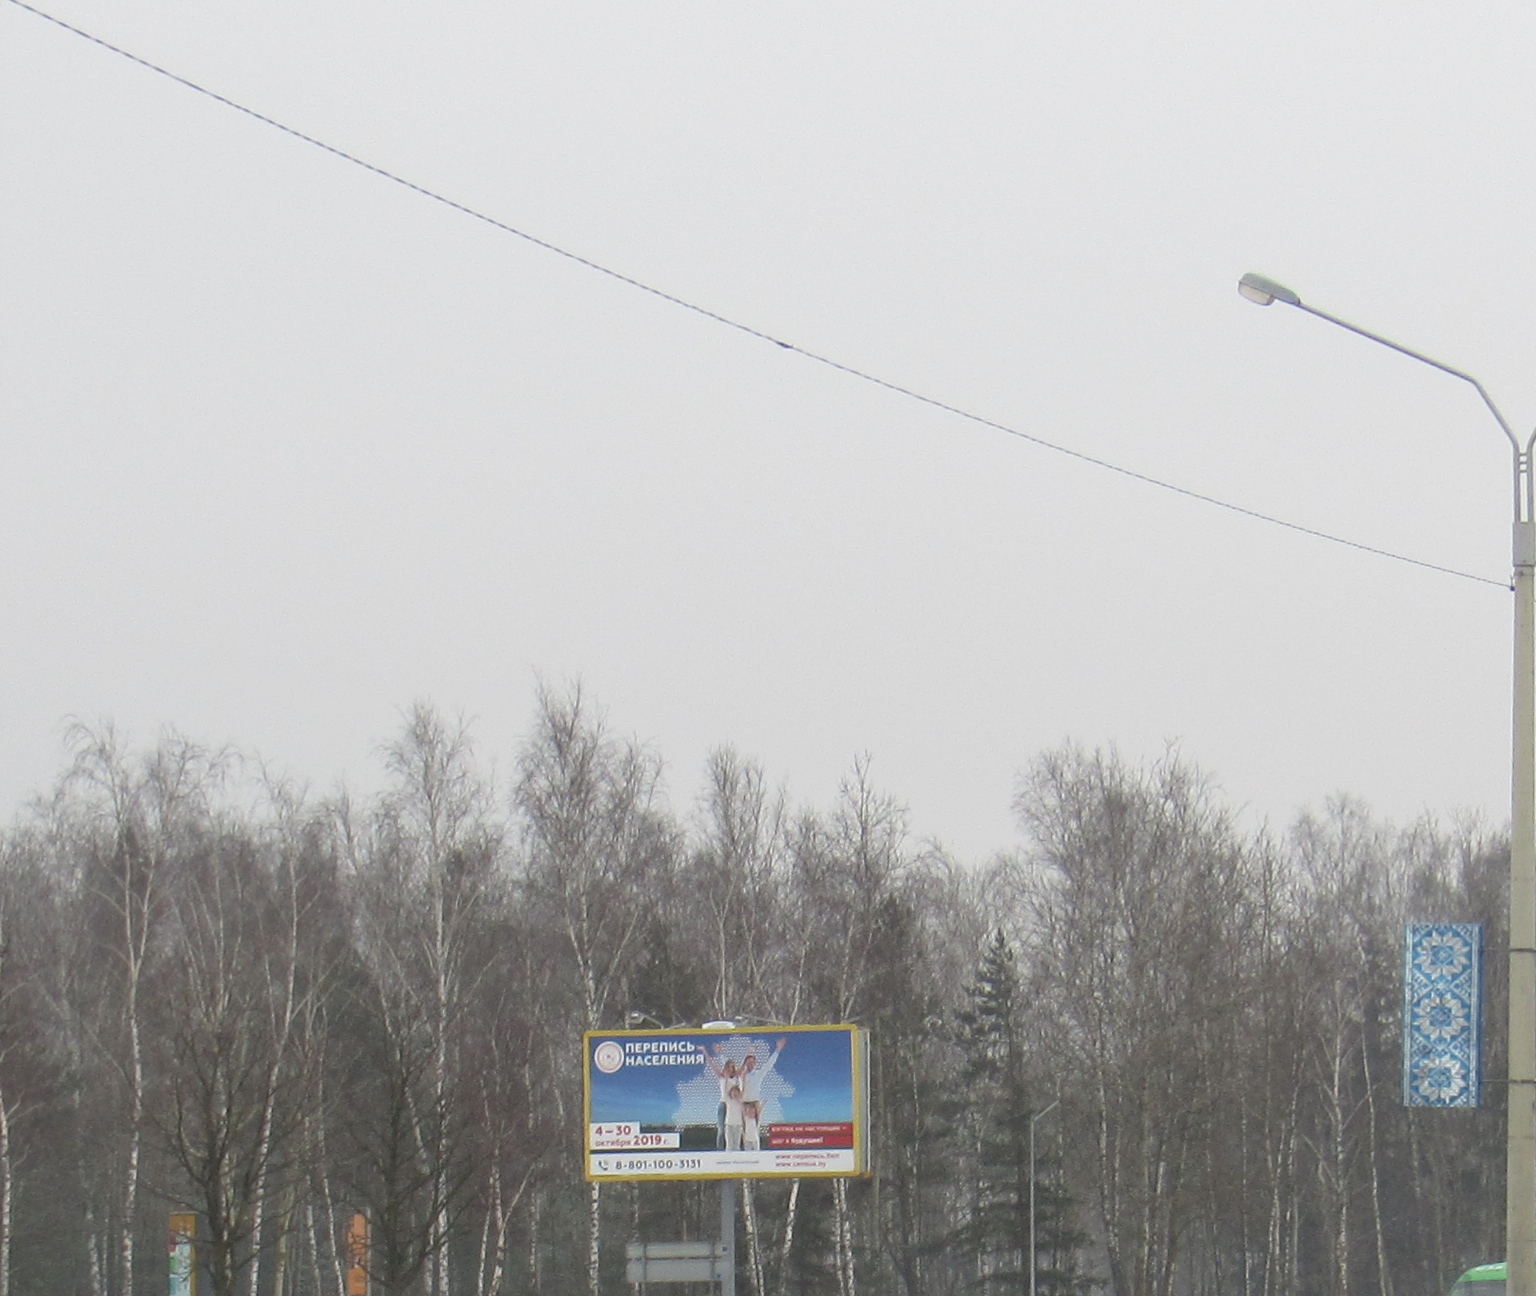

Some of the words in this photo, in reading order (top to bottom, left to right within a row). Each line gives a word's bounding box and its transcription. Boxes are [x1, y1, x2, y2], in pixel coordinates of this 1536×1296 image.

[626, 1042, 695, 1053] ПЕРЕПИСЬ
[626, 1055, 704, 1066] НАСЕЛЕНИЯ
[595, 1138, 631, 1147] октября
[633, 1135, 662, 1146] 2019
[616, 1160, 701, 1170] 8-801-100-3131
